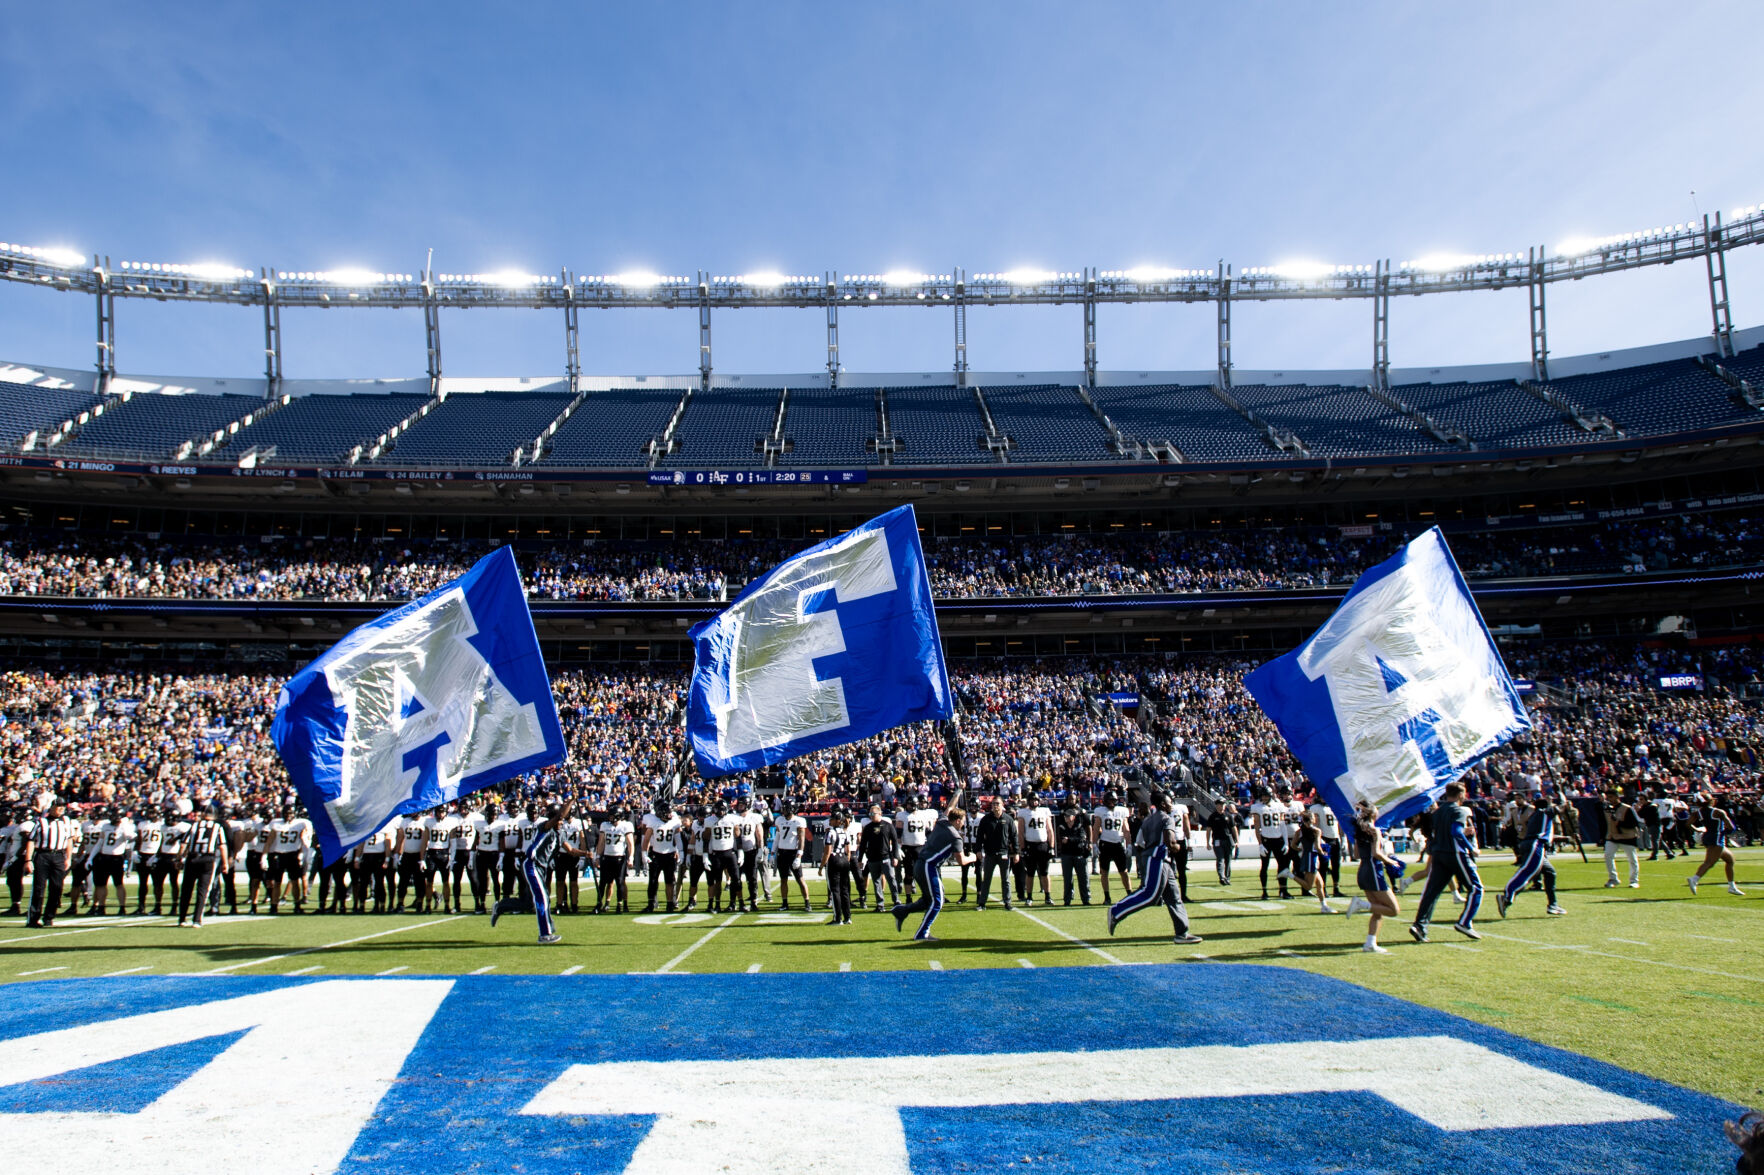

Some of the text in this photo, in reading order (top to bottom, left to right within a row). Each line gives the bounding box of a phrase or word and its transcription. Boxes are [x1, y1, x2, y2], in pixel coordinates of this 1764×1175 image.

[68, 461, 115, 472] 21 MINGO
[161, 467, 197, 476] REEVES
[255, 470, 286, 478] LYNCH
[339, 471, 364, 479] ELAM
[409, 472, 441, 480] BAILEY
[486, 472, 533, 481] SHANAHAN
[696, 473, 704, 482] 0
[736, 473, 744, 482] 0
[775, 473, 796, 481] 2:20
[716, 527, 897, 759] F
[322, 586, 547, 847] A
[107, 832, 117, 846] 6
[142, 829, 161, 843] 26
[280, 830, 298, 844] 53
[430, 829, 449, 843] 80
[484, 831, 493, 845] 3
[656, 829, 674, 842] 36
[713, 827, 732, 840] 95
[782, 826, 791, 840] 7
